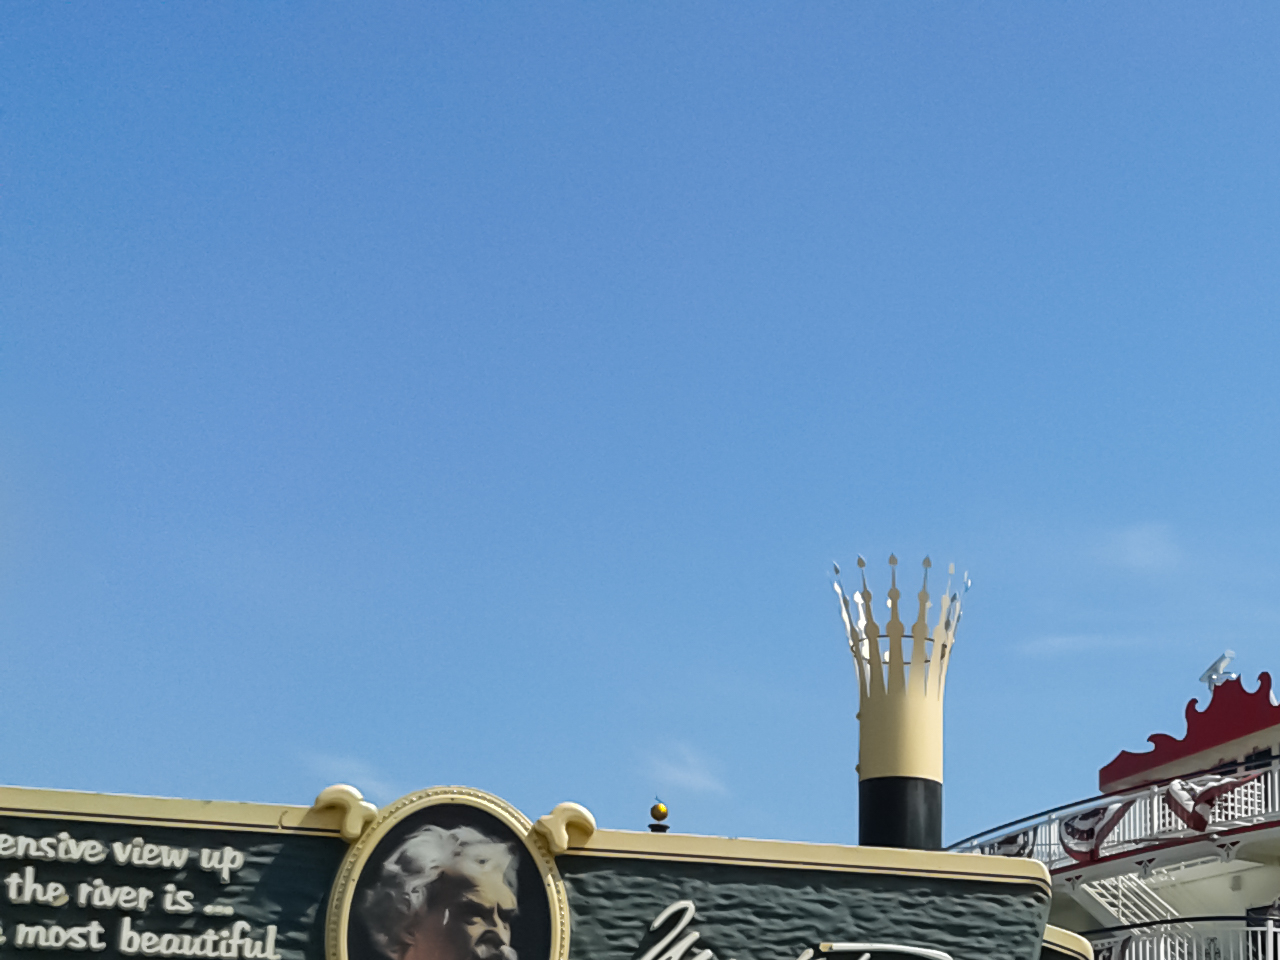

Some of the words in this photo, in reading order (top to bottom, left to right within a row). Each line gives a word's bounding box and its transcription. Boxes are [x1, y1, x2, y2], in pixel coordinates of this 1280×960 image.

[112, 837, 189, 868] view
[200, 846, 245, 884] up
[4, 865, 69, 906] the
[78, 877, 153, 912] river
[163, 883, 195, 913] is
[15, 920, 106, 951] most
[119, 916, 282, 960] beautiful
